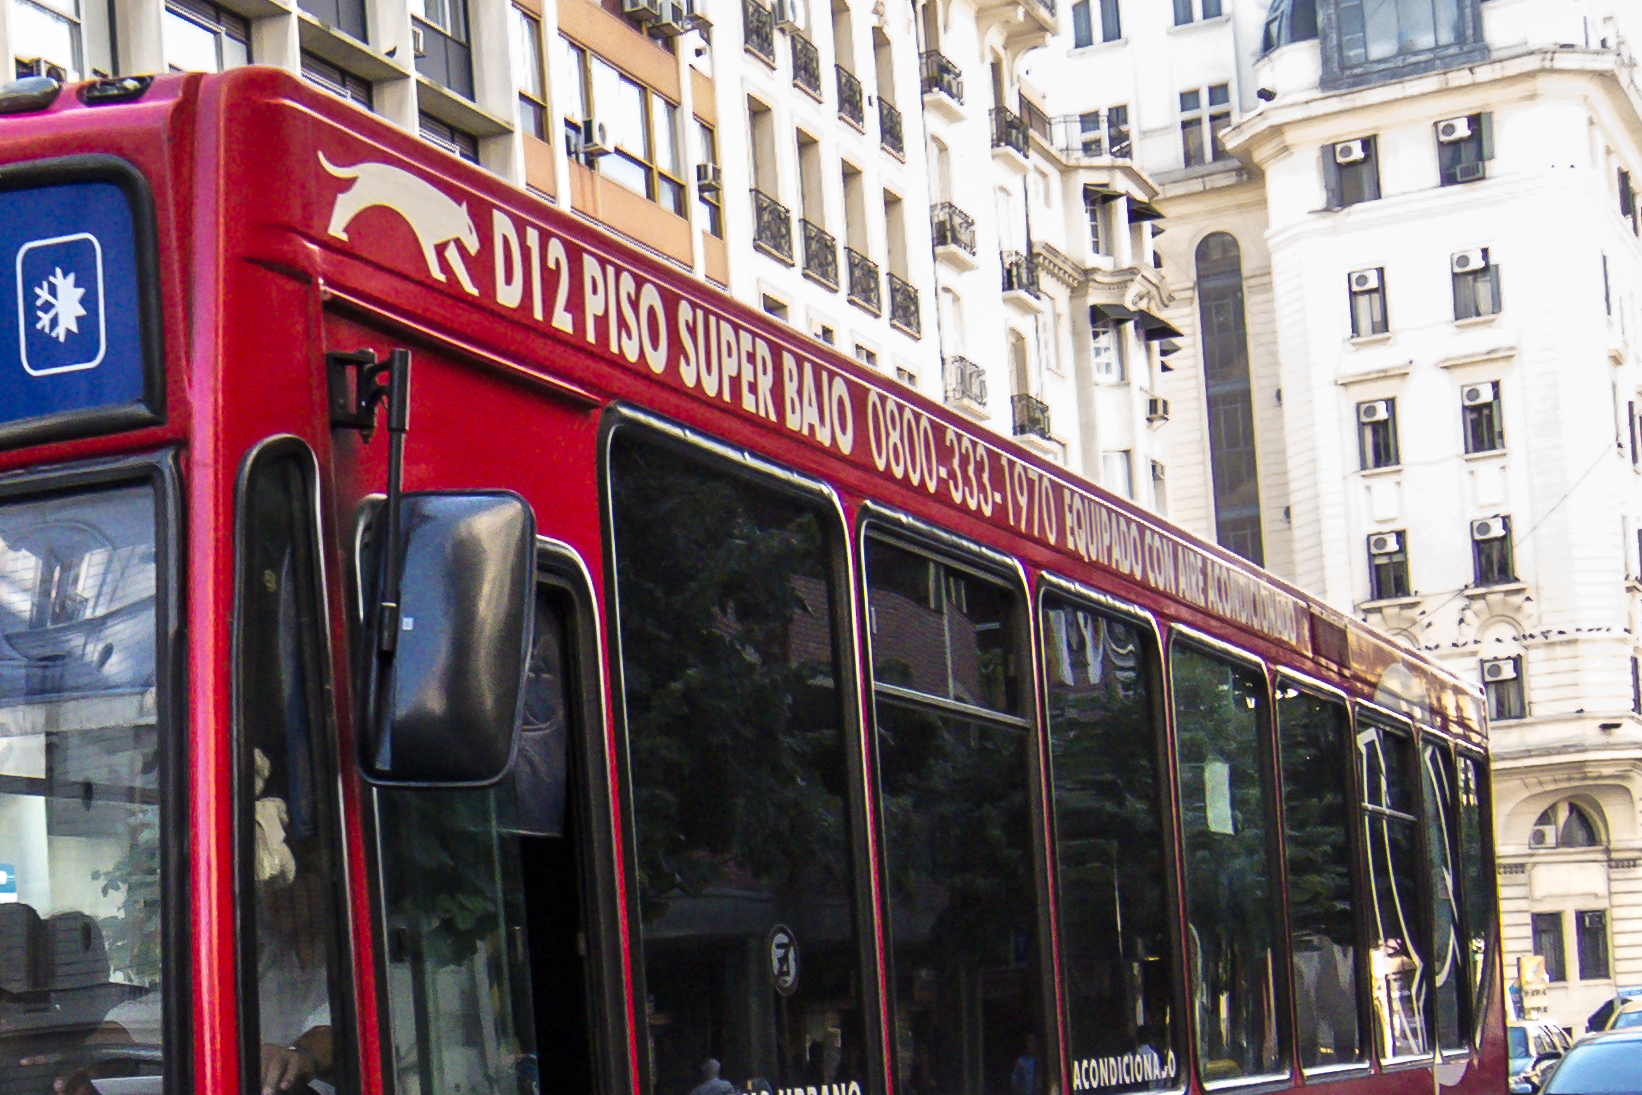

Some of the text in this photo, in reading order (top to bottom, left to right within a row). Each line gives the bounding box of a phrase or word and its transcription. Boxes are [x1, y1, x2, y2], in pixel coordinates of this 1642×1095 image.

[491, 208, 575, 335] D12
[582, 251, 669, 375] PISO
[677, 299, 778, 423] SUPER
[782, 350, 854, 457] BAJO
[867, 388, 1057, 546] 0800-333-1970
[1063, 487, 1143, 582] EQUIPADO
[1144, 528, 1178, 595] CON
